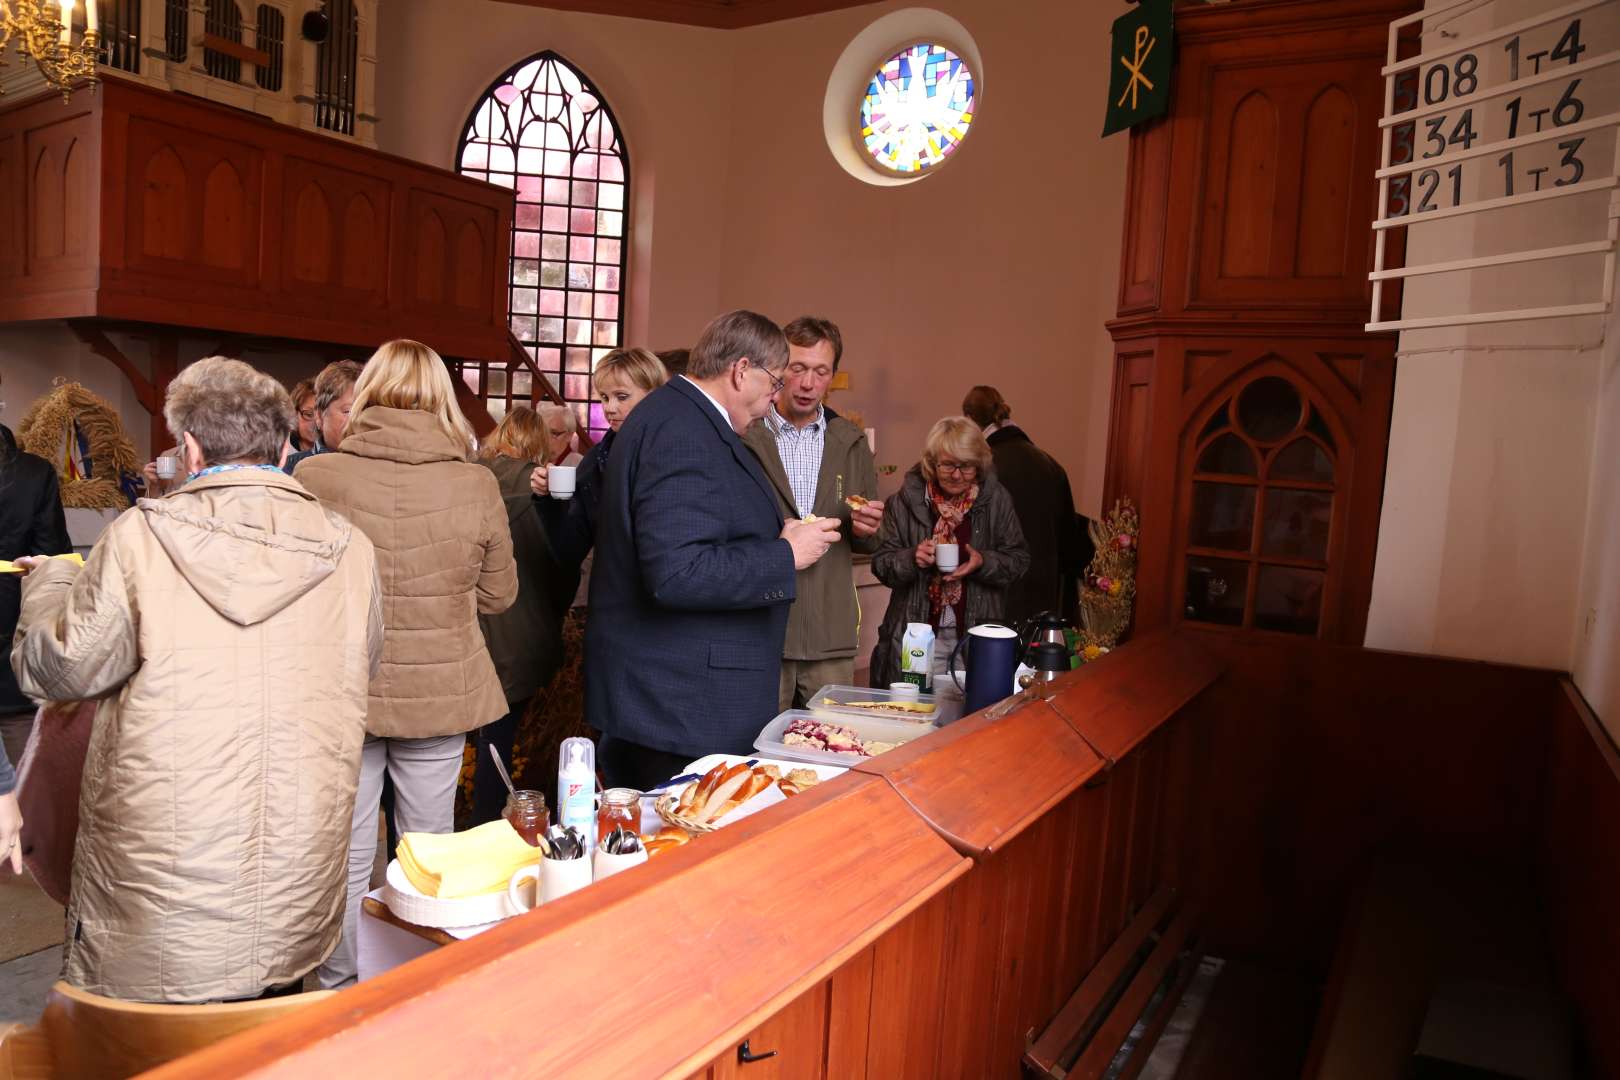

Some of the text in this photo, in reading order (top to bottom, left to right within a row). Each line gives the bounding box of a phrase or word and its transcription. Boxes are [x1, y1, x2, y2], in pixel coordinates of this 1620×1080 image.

[1395, 53, 1478, 115] 508
[1391, 109, 1477, 165] 334
[1387, 164, 1461, 218] 321
